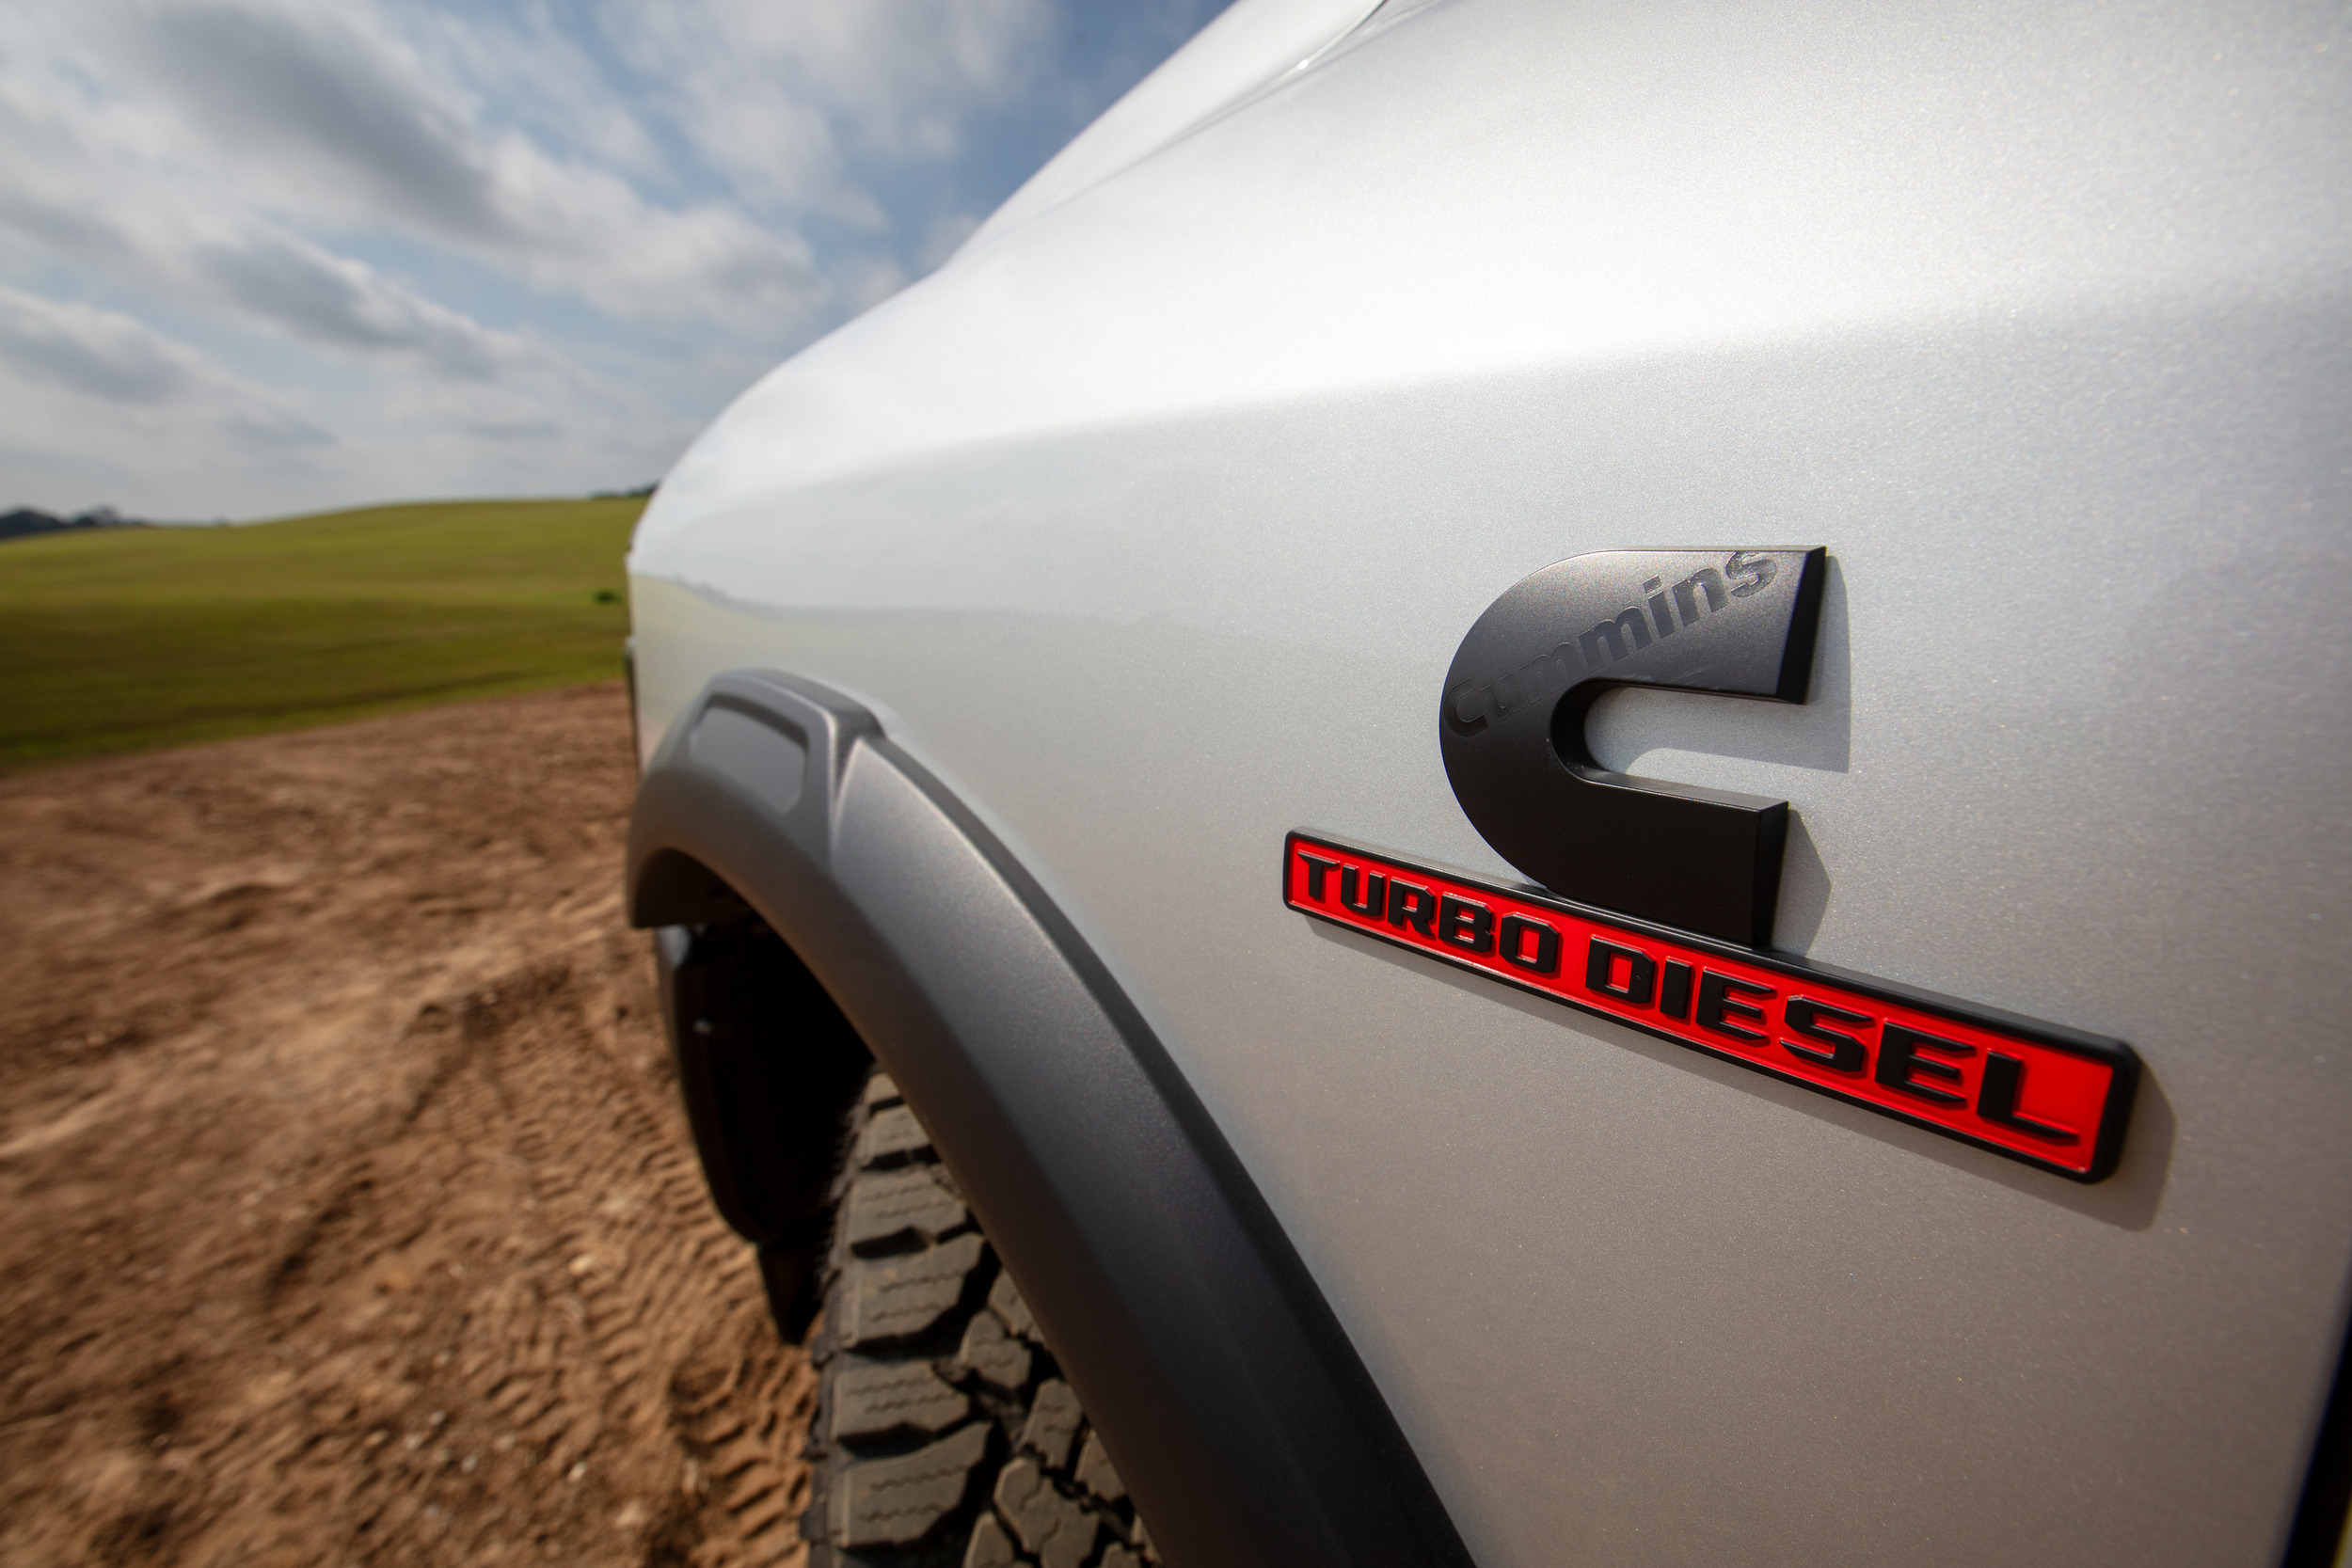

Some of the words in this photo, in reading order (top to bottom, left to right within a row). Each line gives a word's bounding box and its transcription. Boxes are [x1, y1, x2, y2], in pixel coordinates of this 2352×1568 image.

[1442, 550, 1778, 737] Cummins
[1296, 849, 1561, 974] TURBO
[1584, 934, 2080, 1145] DIESEL
